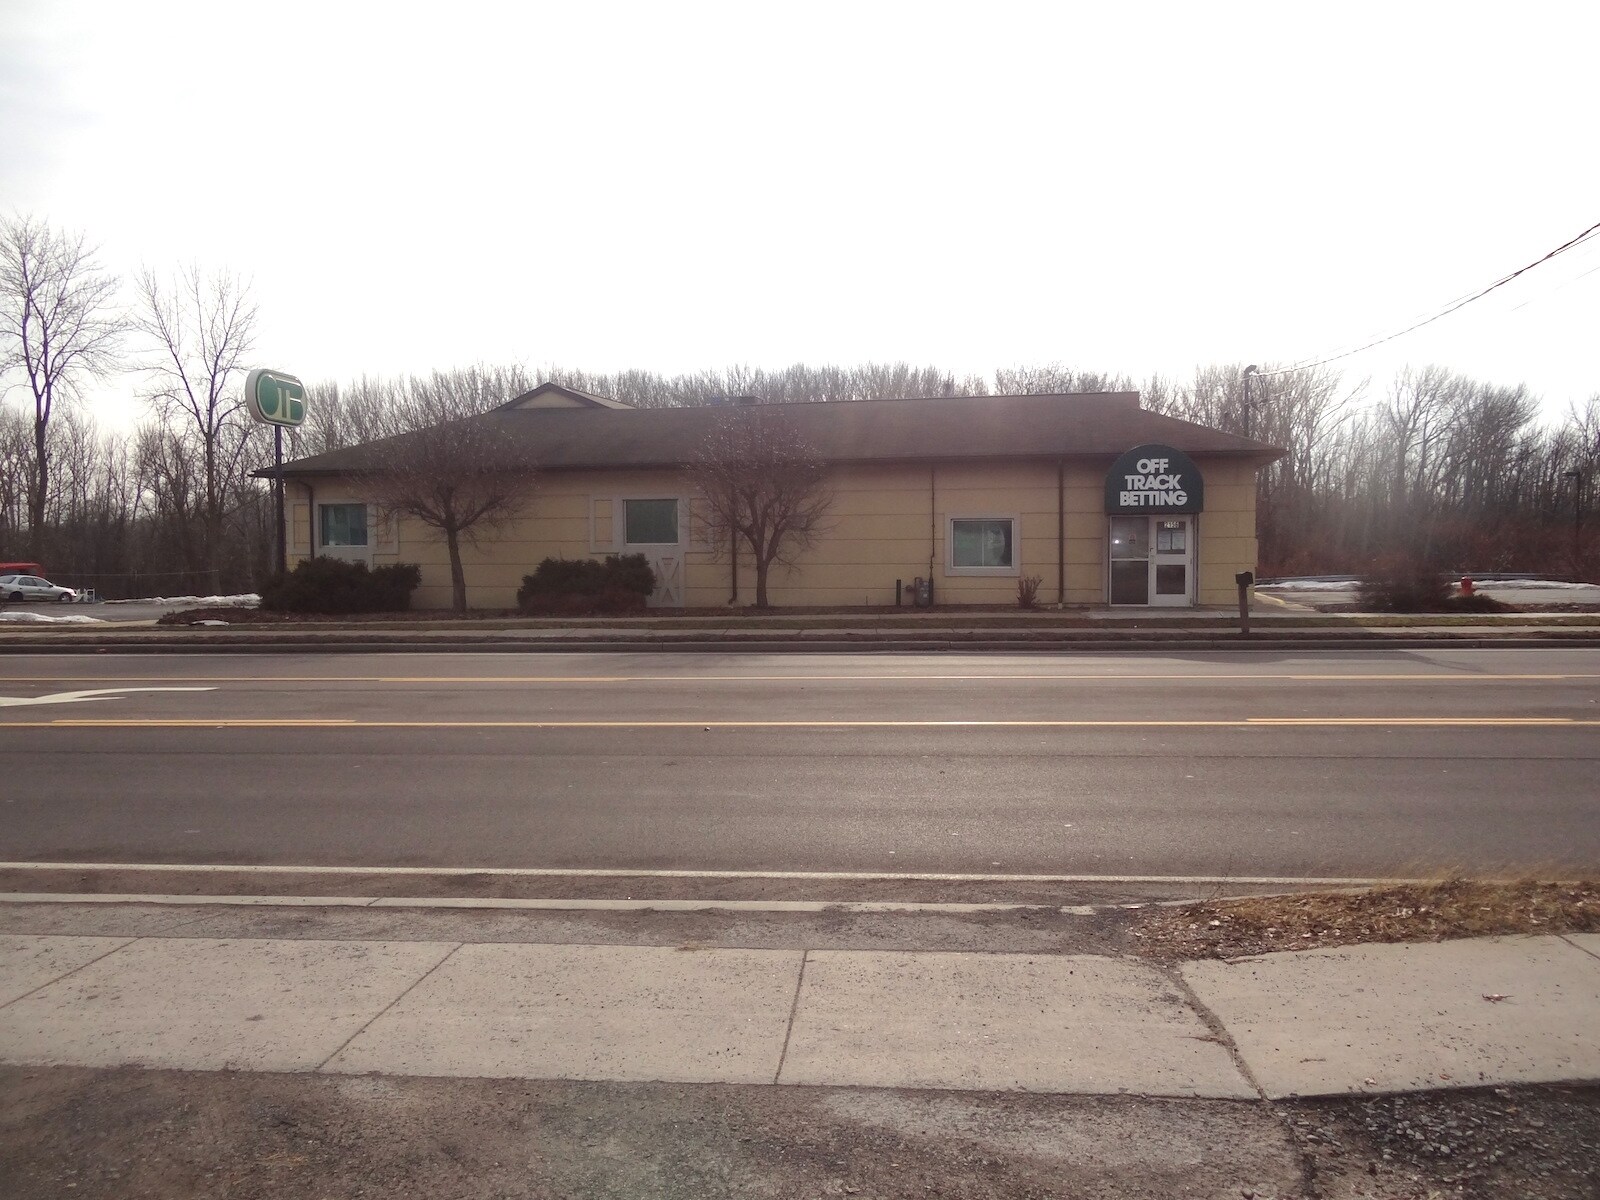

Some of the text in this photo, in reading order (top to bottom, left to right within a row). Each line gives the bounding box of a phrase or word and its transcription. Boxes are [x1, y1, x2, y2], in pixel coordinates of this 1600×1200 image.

[1136, 458, 1169, 474] OFF
[1125, 475, 1182, 490] TRACK
[1119, 491, 1188, 506] BETTING
